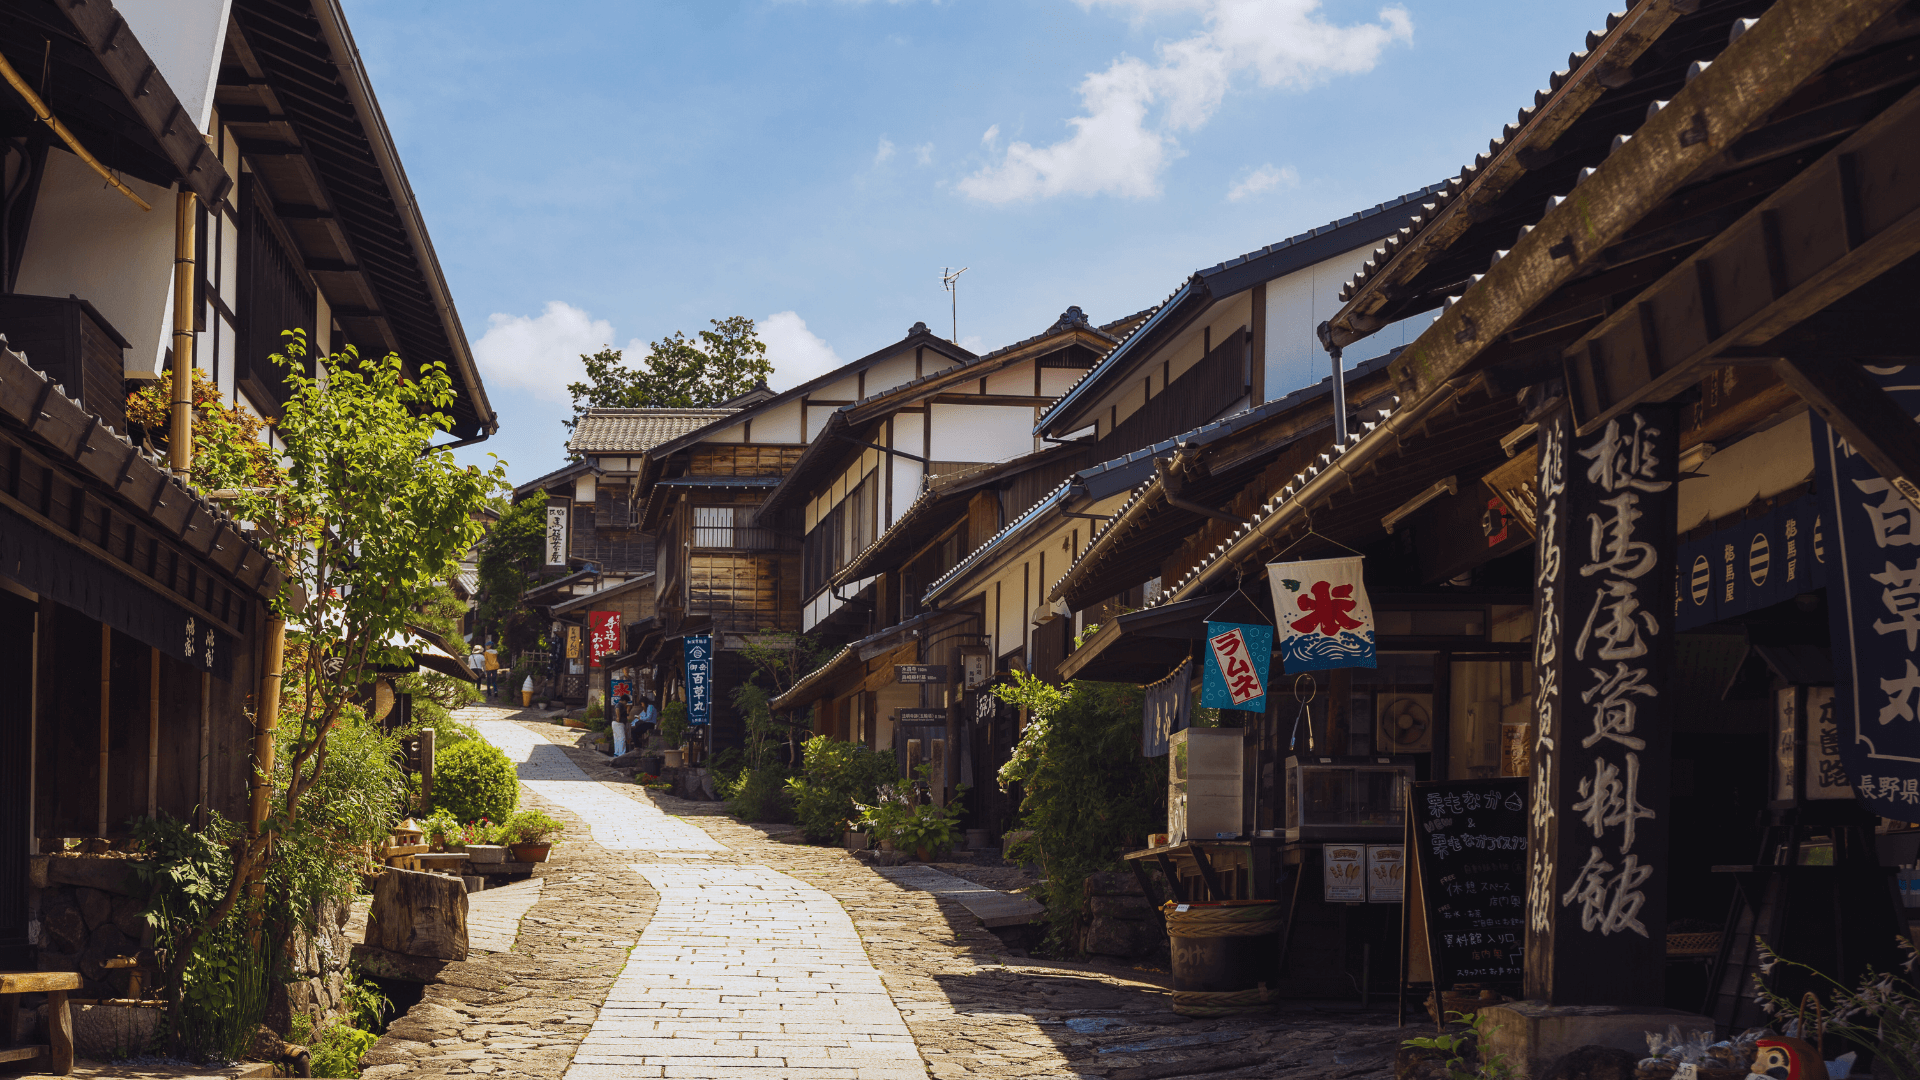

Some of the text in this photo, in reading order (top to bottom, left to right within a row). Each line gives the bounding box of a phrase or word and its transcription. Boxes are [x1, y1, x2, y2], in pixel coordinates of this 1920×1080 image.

[1290, 580, 1365, 636] 氷
[603, 615, 618, 649] 手造り
[1215, 633, 1259, 699] ラムネ
[1563, 412, 1673, 938] 槌馬屋資料館
[691, 671, 707, 711] 百草丸
[1427, 790, 1502, 817] 栗もなか
[1857, 774, 1920, 805] 長野県
[1423, 817, 1453, 833] NEW
[1467, 818, 1476, 828] &
[1431, 833, 1528, 860] 栗もなかアイスクリ
